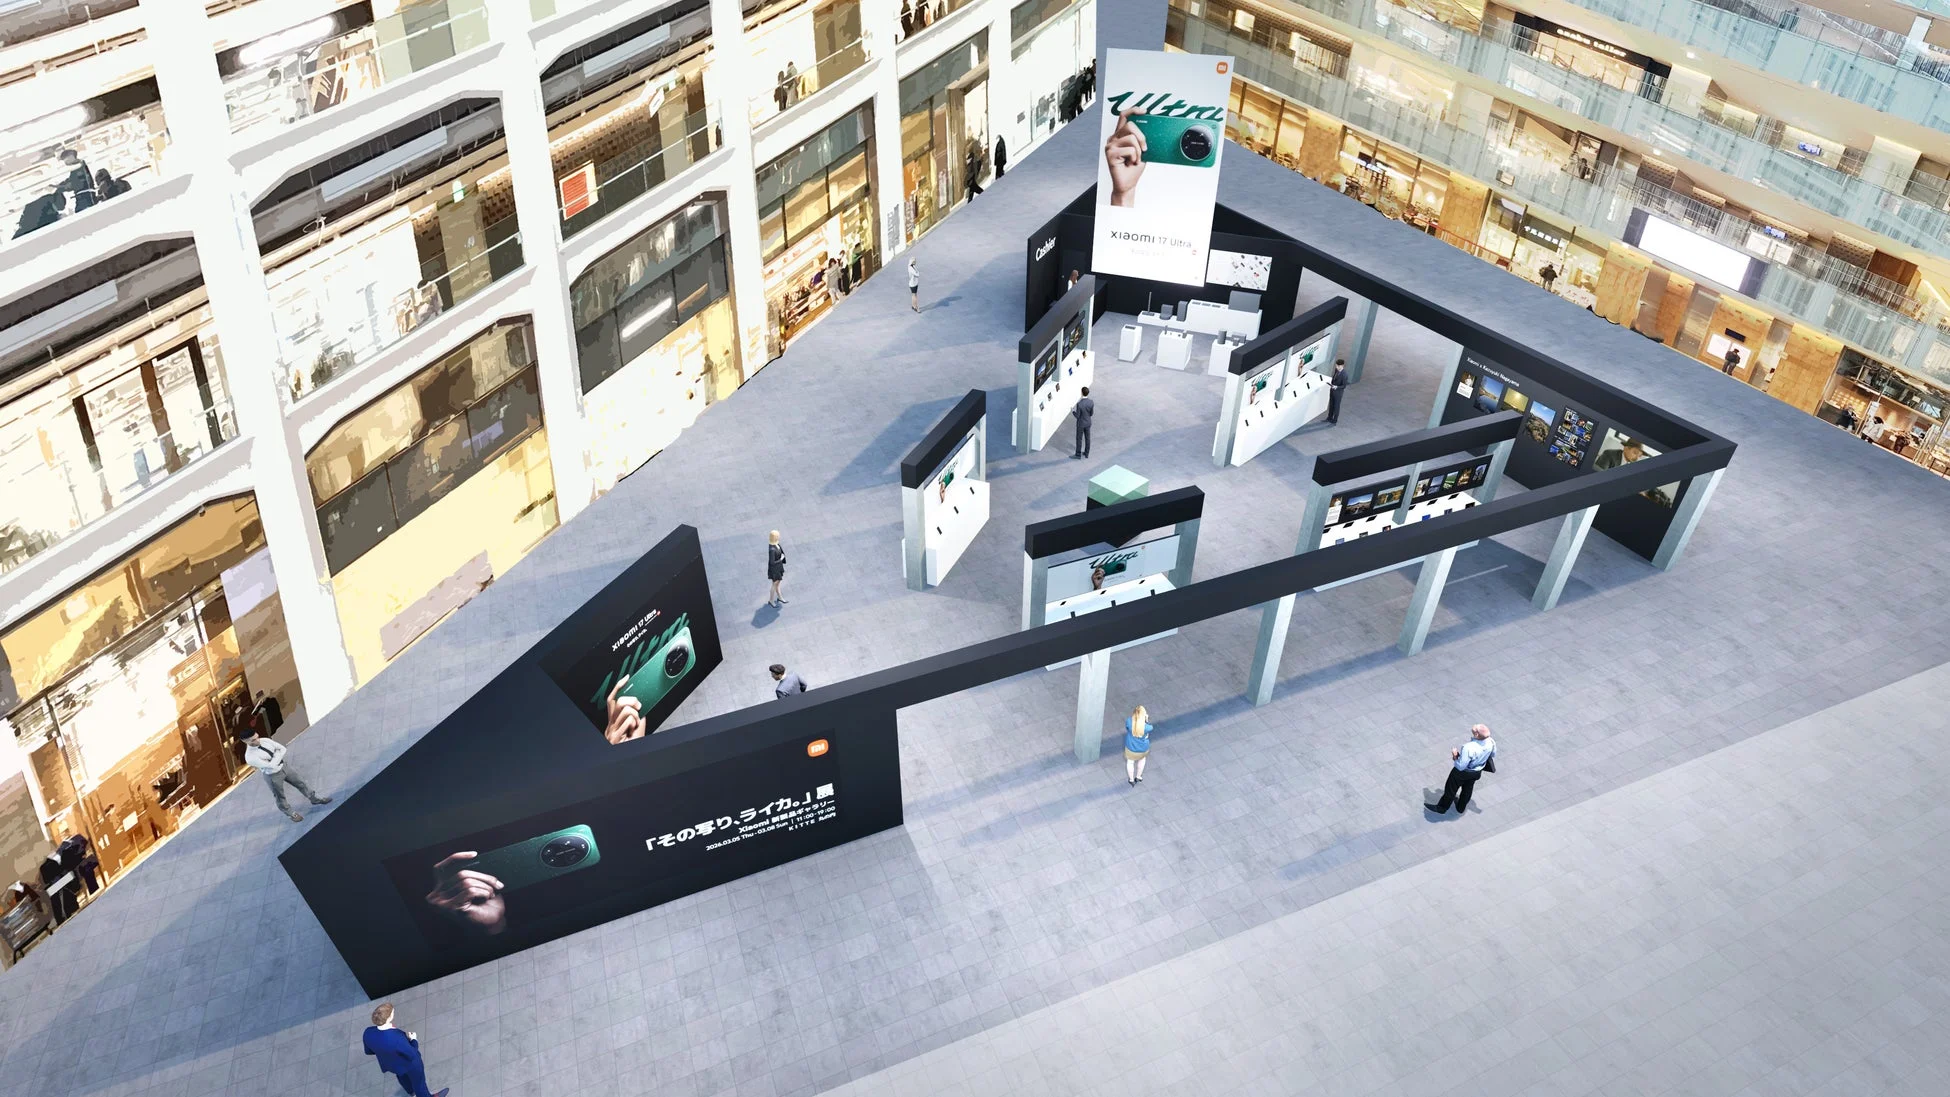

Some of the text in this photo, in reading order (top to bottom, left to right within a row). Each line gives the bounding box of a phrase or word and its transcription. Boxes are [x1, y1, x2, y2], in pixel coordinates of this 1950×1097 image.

[1107, 91, 1224, 122] Ultra
[1035, 236, 1057, 262] Cashier
[1158, 236, 1168, 245] 17
[1170, 238, 1192, 248] Ultra
[1089, 551, 1139, 569] Ultra
[738, 818, 770, 834] Xiaomi
[741, 831, 755, 840] Thu
[775, 821, 789, 829] Sun
